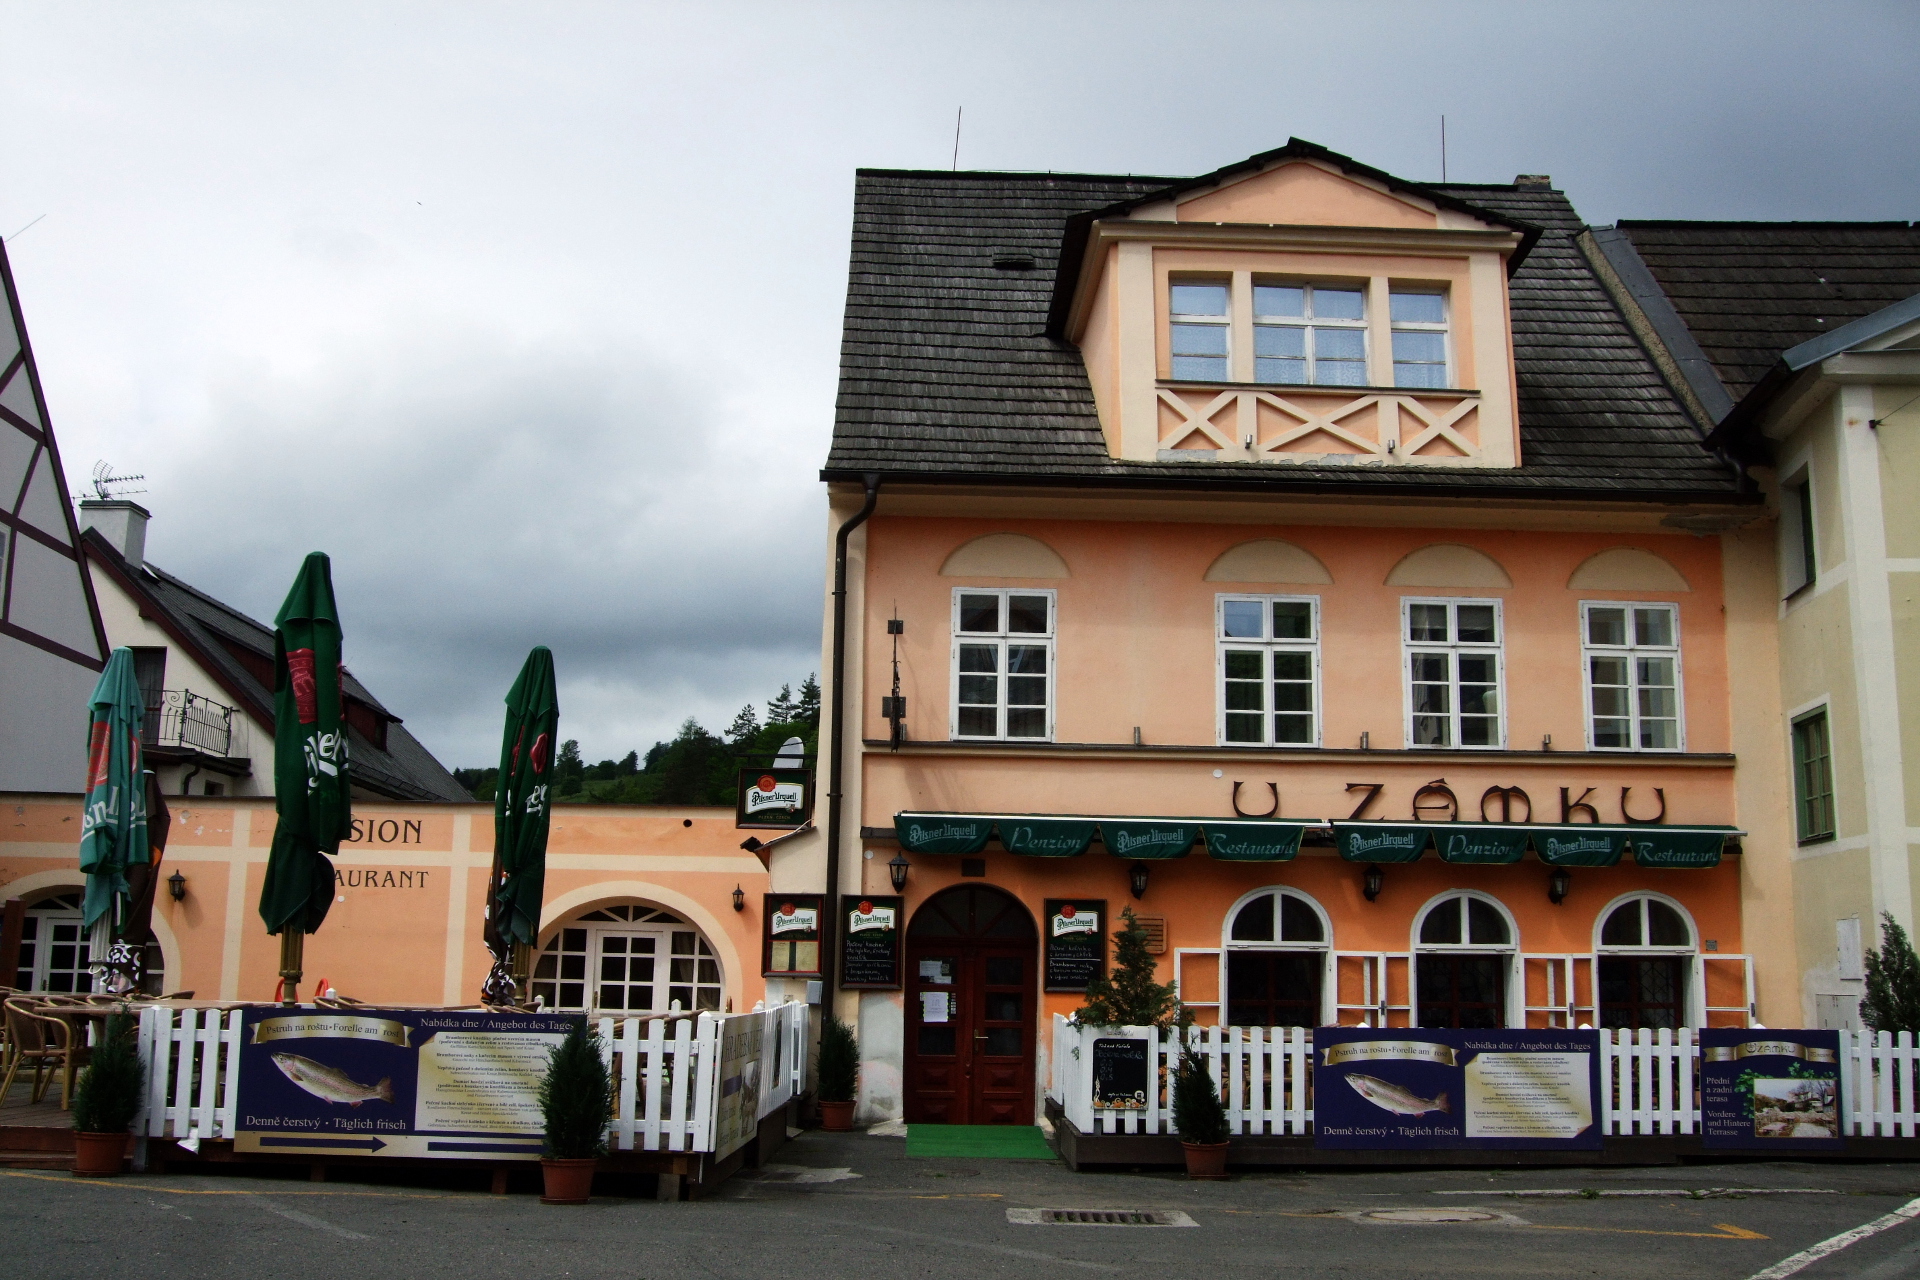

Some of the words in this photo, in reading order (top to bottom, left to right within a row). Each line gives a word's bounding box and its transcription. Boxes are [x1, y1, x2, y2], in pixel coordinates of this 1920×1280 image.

[752, 791, 775, 806] Pilsner
[775, 791, 797, 803] Urquell
[1232, 780, 1278, 819] U
[340, 818, 422, 843] SION
[909, 824, 943, 846] Pilsner
[943, 823, 977, 839] Urquell
[1009, 826, 1081, 851] Penzion
[1117, 830, 1150, 853] Pilsner
[1150, 828, 1184, 845] Urquell
[1209, 833, 1295, 855] Restaurant
[1350, 833, 1382, 856] Pilsner
[1382, 832, 1414, 848] Urquell
[1446, 834, 1515, 860] Penzion
[1547, 837, 1579, 860] Pilsner
[1579, 836, 1610, 852] Urquell
[1637, 841, 1718, 862] Restaurant
[335, 870, 430, 888] AURANT
[776, 915, 795, 928] Pilsner
[795, 915, 813, 923] Urquell
[854, 914, 872, 926] Pilsner
[872, 914, 891, 924] Urquell
[1056, 918, 1075, 930] Pilsner
[266, 1023, 293, 1035] Pstruh
[308, 1023, 328, 1031] roštu
[333, 1022, 363, 1033] Forelle
[365, 1027, 378, 1035] am
[383, 1029, 399, 1038] rost
[420, 1018, 459, 1028] Nabídka
[462, 1019, 479, 1028] dne
[487, 1020, 527, 1031] Angebot
[529, 1020, 545, 1030] des
[548, 1021, 574, 1032] Tages
[1335, 1048, 1358, 1057] Pstruh
[1392, 1046, 1416, 1054] Forelle
[1464, 1041, 1497, 1050] Nabídka
[1498, 1042, 1513, 1050] dne
[1520, 1042, 1553, 1051] Angebot
[1554, 1042, 1567, 1050] des
[1569, 1042, 1591, 1051] Tages
[1706, 1077, 1730, 1085] Přední
[1712, 1086, 1733, 1094] zadní
[1707, 1110, 1736, 1118] Vordere
[246, 1115, 281, 1126] Denně
[282, 1116, 321, 1130] čerstvý
[333, 1117, 373, 1130] Täglich
[376, 1118, 406, 1130] frisch
[1323, 1126, 1353, 1135] Denně
[1355, 1127, 1388, 1137] čerstvý
[1397, 1127, 1432, 1137] Täglich
[1434, 1127, 1459, 1136] frisch
[1708, 1128, 1739, 1136] Terrasse
